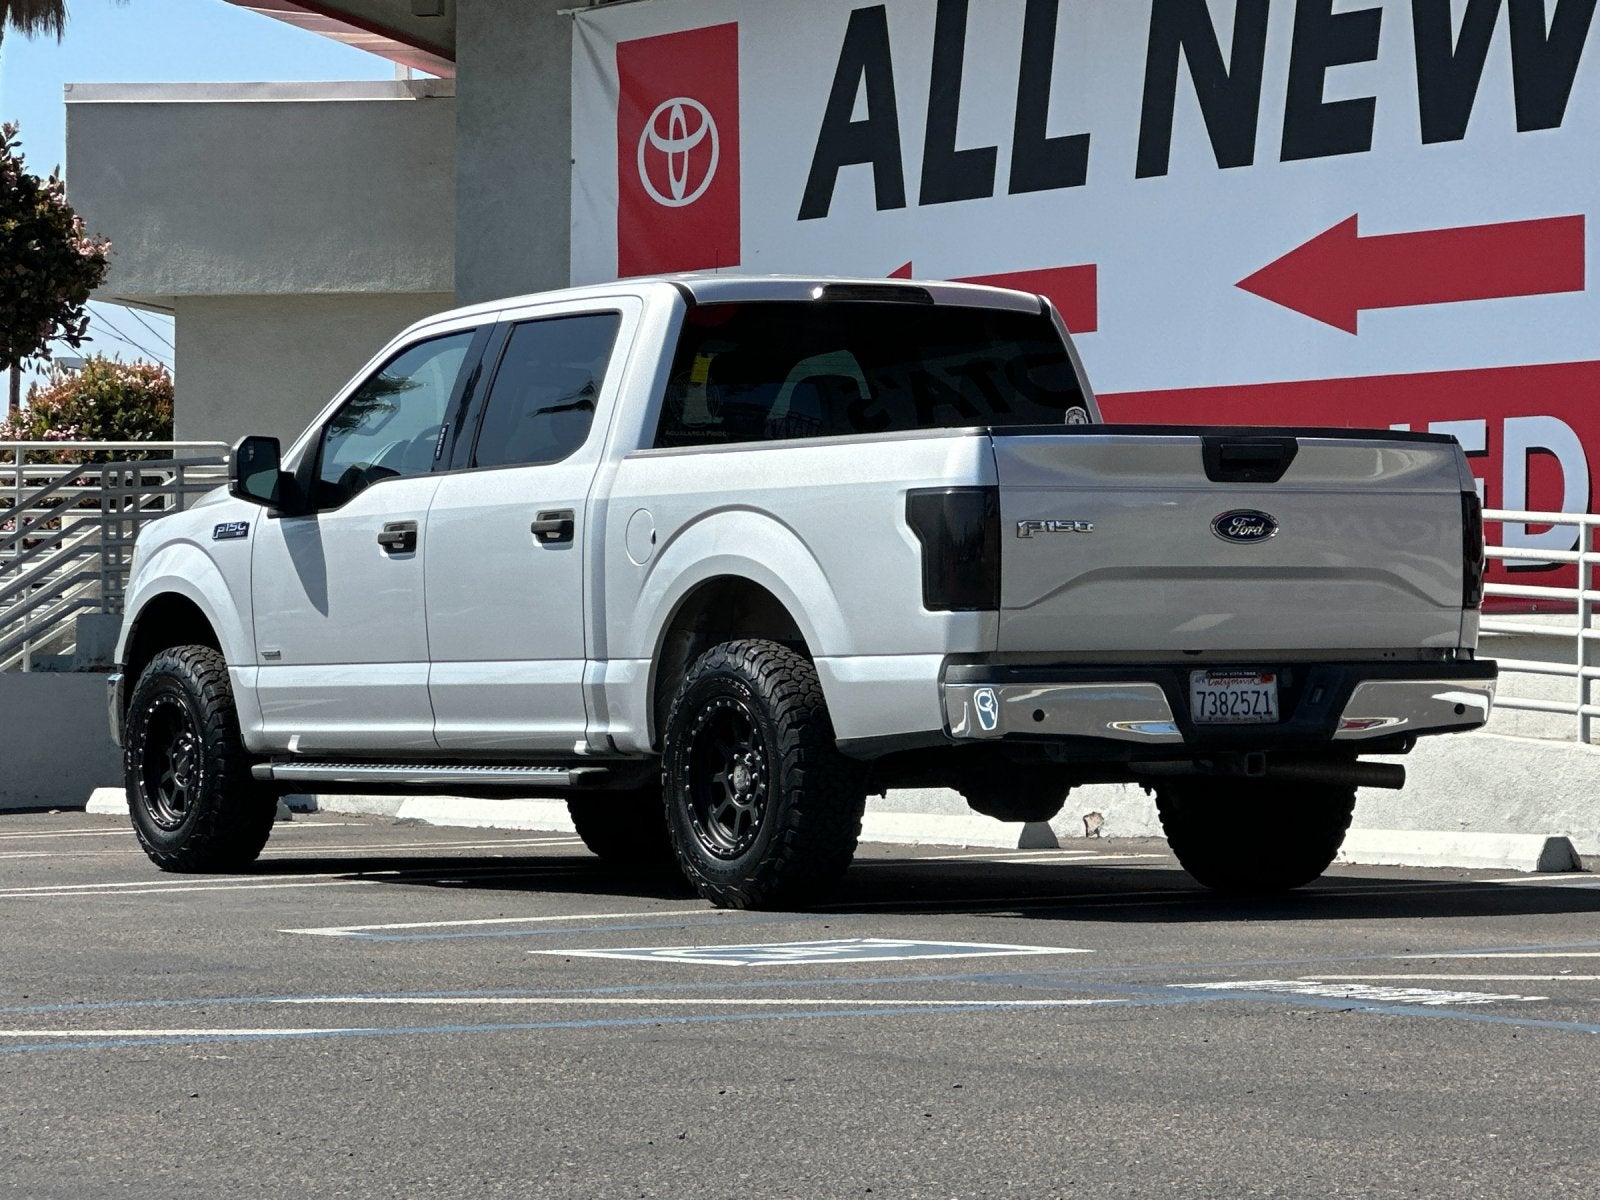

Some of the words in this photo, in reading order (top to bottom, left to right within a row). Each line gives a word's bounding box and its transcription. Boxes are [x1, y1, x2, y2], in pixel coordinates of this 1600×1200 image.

[798, 0, 1090, 221] ALL
[1135, 0, 1597, 180] NEW
[1228, 516, 1264, 536] Ford
